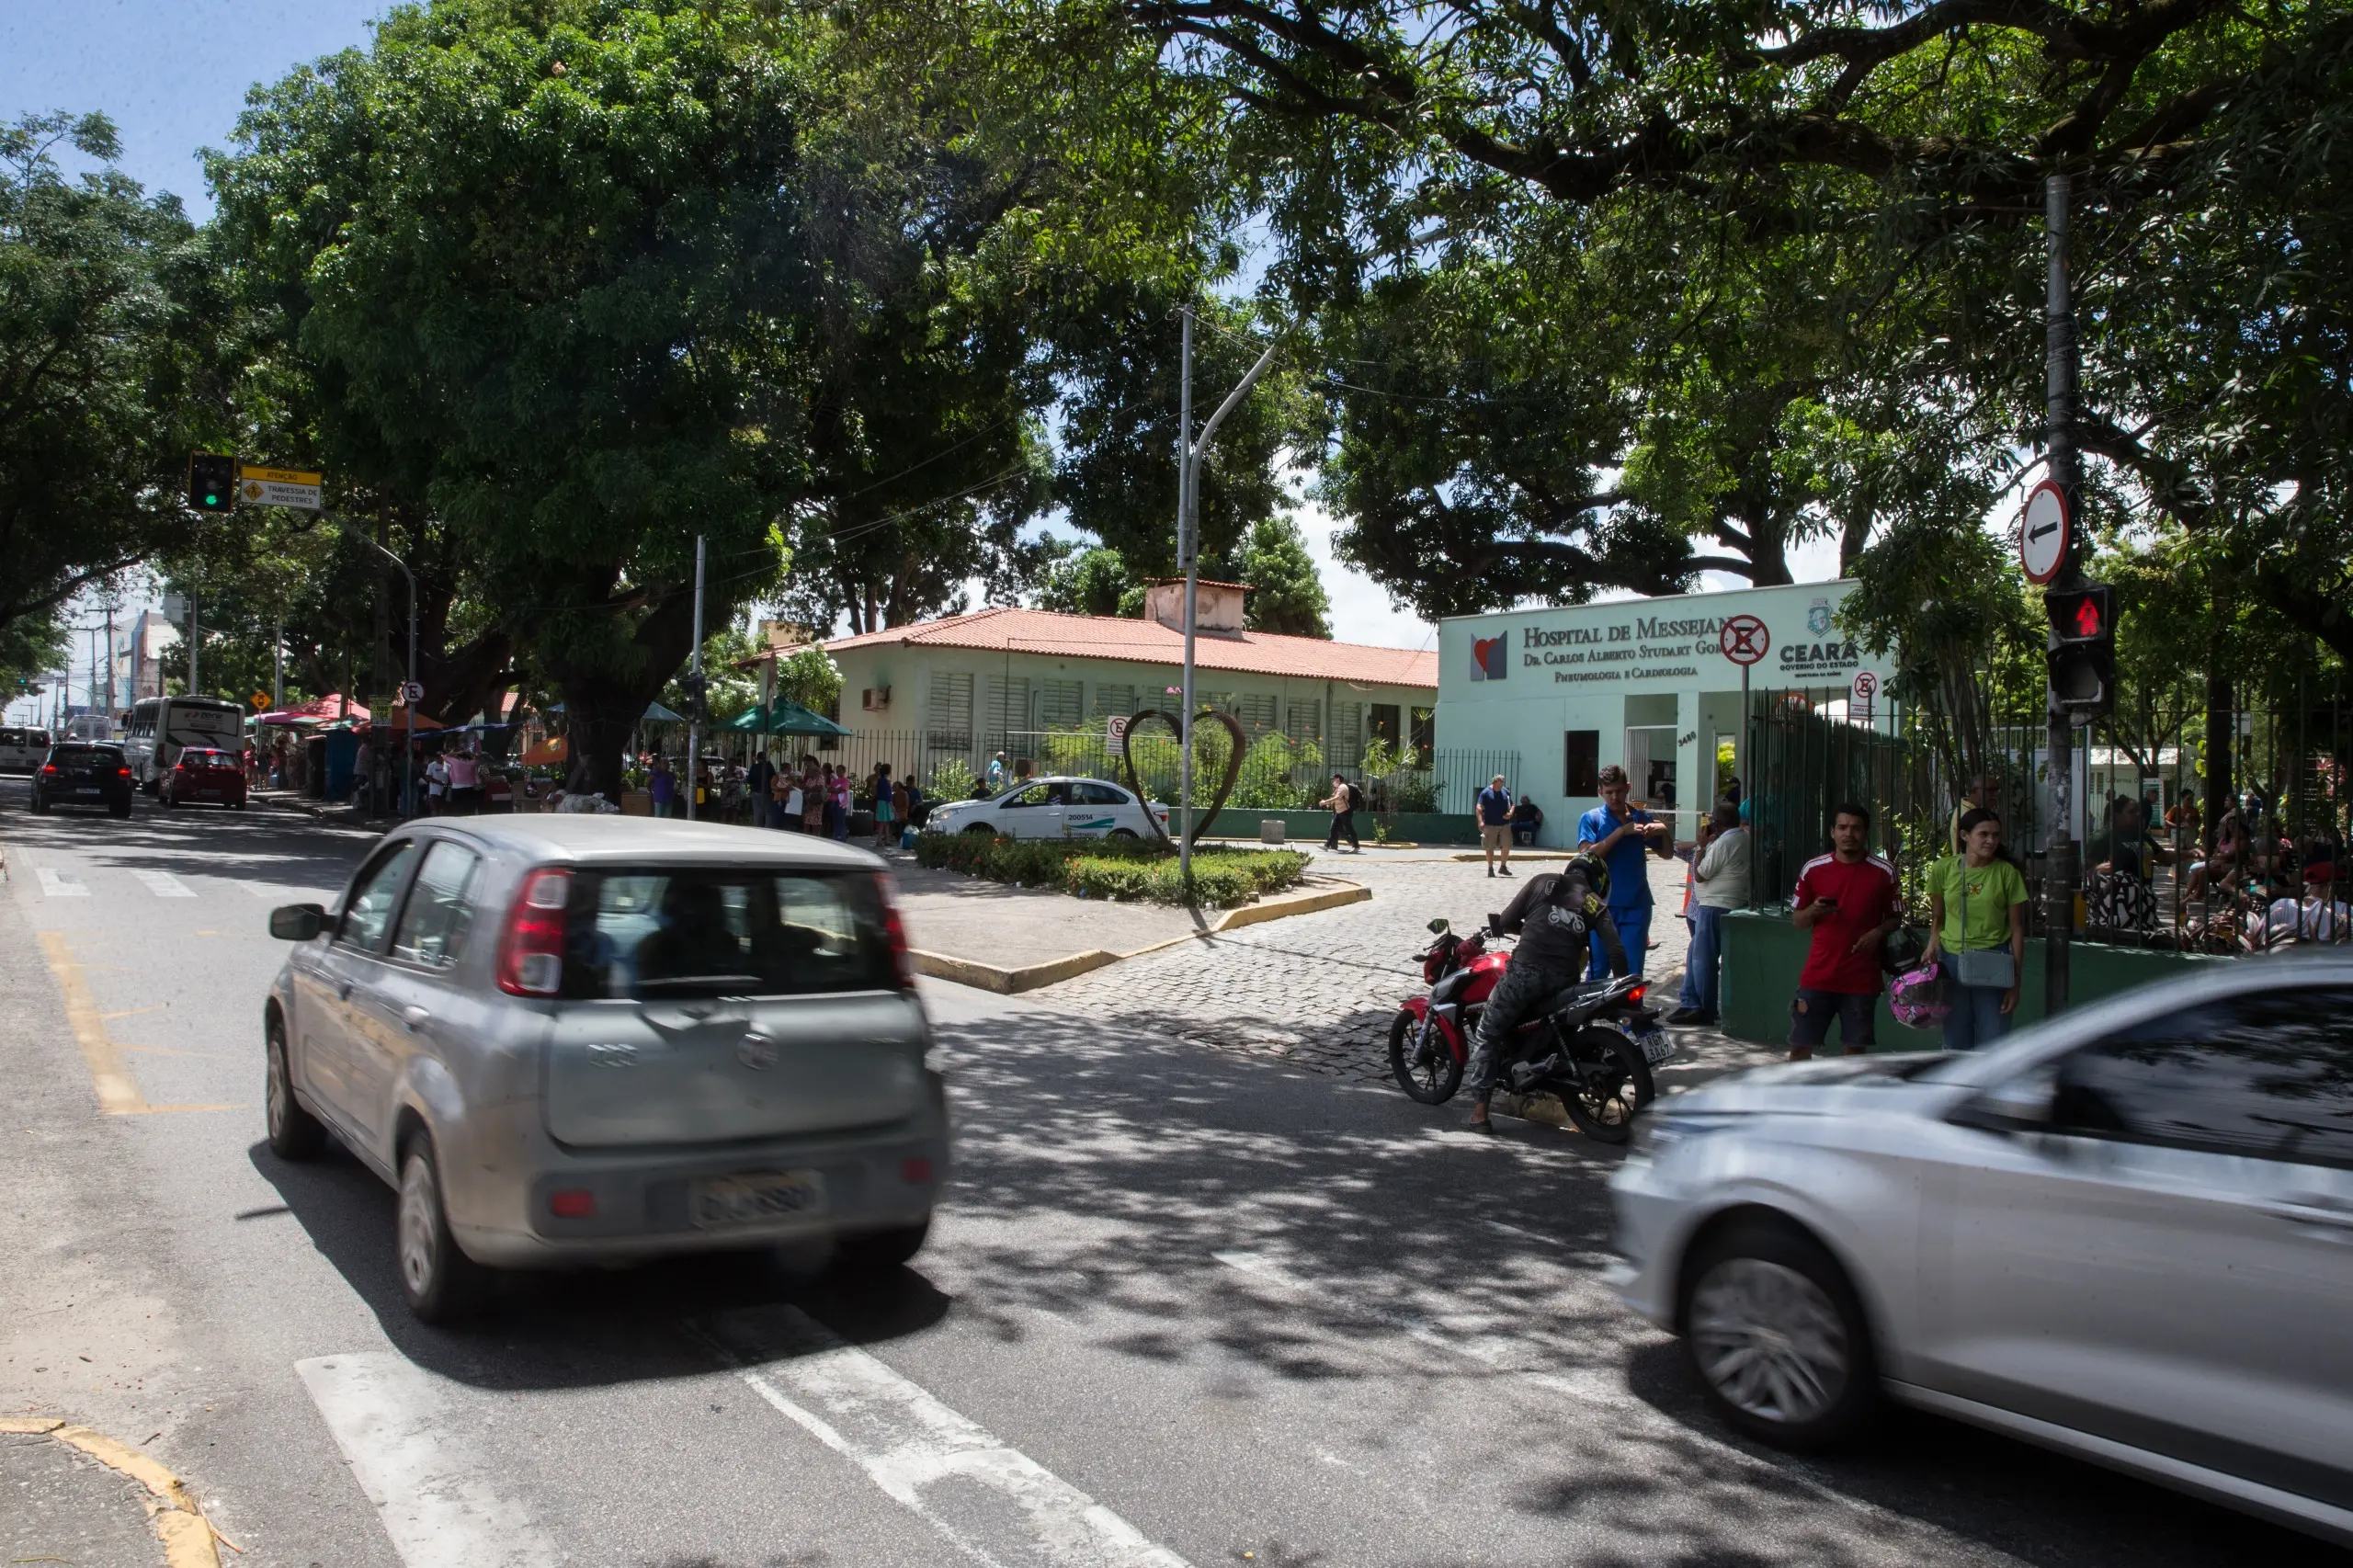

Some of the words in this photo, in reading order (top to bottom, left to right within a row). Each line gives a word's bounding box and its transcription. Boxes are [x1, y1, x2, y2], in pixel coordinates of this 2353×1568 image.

[267, 472, 298, 481] ATENÇÃO
[267, 485, 306, 495] TRAVESSIA
[271, 494, 313, 505] PEDESTRES
[1523, 627, 1603, 648] HOSPITAL
[1608, 625, 1631, 642] DE
[1636, 617, 1733, 640] MESSEJAN
[1523, 653, 1542, 666] DR.
[1544, 652, 1585, 665] CARLOS
[1586, 649, 1636, 663] ALBERTO
[1639, 645, 1692, 658] STUDART
[1779, 662, 1815, 671] GOVERNO
[1816, 662, 1828, 670] DO
[1554, 671, 1622, 683] PNEUMOLOGIA
[1631, 666, 1699, 678] CARDIOLOGIA
[1677, 731, 1697, 747] 3480
[1646, 1033, 1665, 1048] RGM
[1648, 1043, 1670, 1060] 3A67
